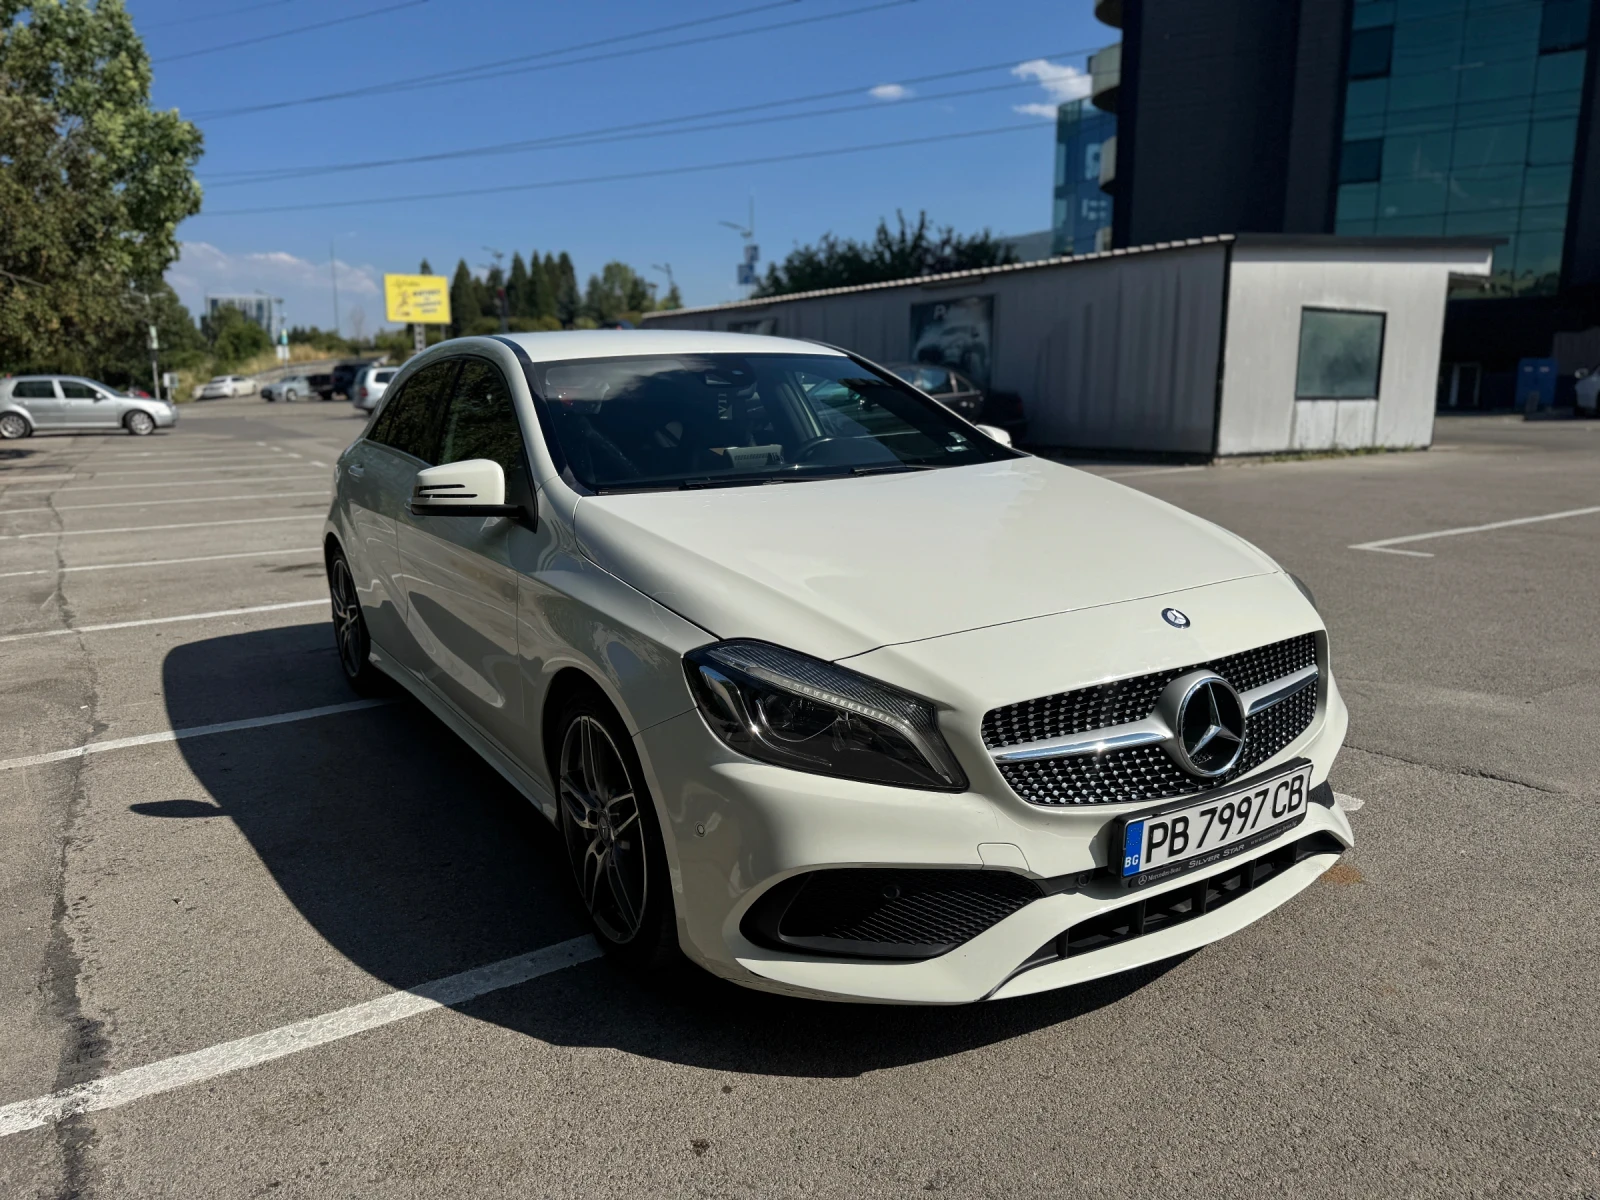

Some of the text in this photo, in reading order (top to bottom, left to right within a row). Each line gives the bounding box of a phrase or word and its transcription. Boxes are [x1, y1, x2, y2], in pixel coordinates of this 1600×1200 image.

[1145, 774, 1305, 864] PB 7997 CB
[1124, 854, 1139, 868] BG
